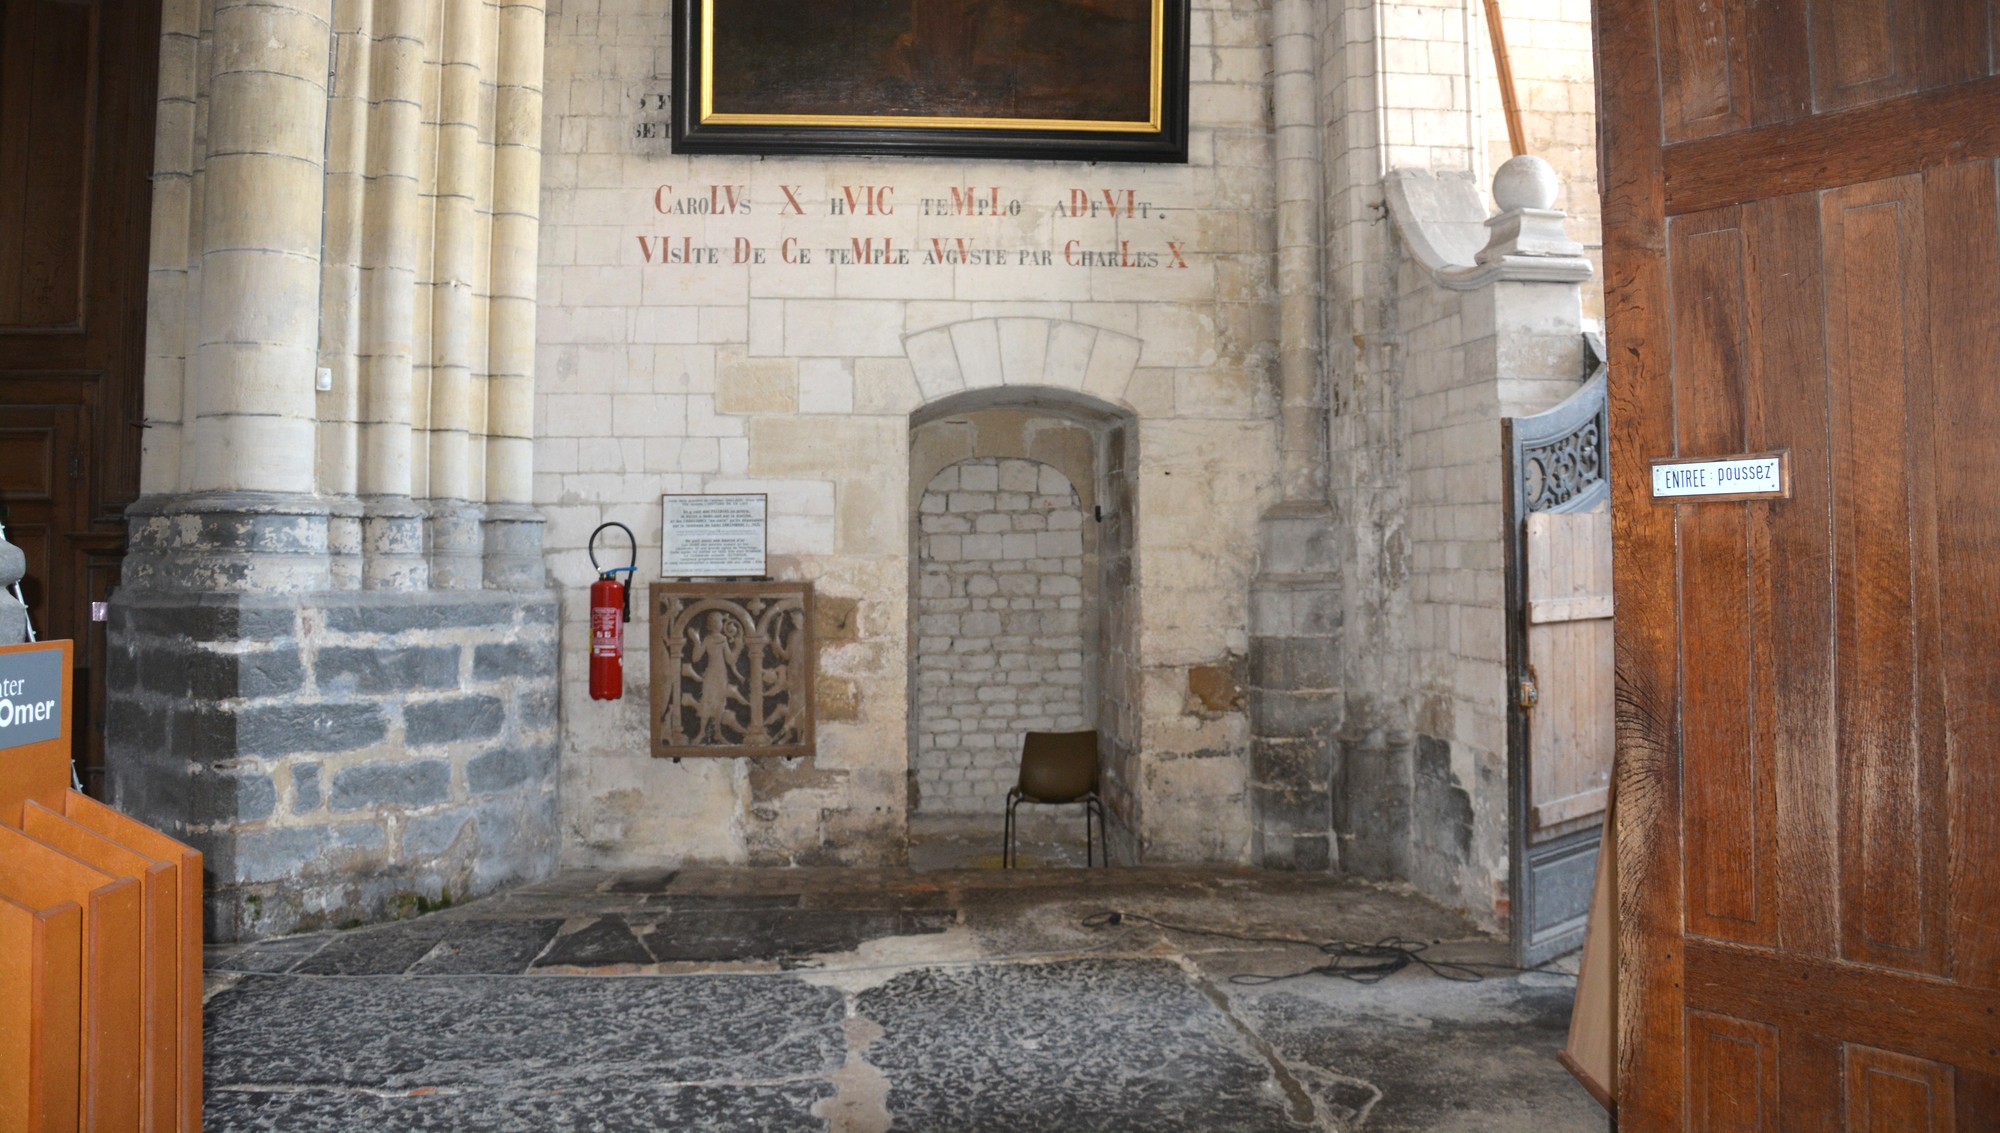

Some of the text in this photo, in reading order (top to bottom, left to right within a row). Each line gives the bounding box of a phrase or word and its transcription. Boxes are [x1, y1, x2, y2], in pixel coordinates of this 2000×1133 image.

[778, 185, 807, 215] X
[830, 185, 894, 216] HVIC
[921, 185, 1021, 217] TEMPLO
[636, 236, 1189, 269] VISITE DE CE TEMPLE AVGVSTE PAR CHARLES X
[1665, 468, 1707, 489] ENTREE
[1717, 465, 1771, 486] poussez
